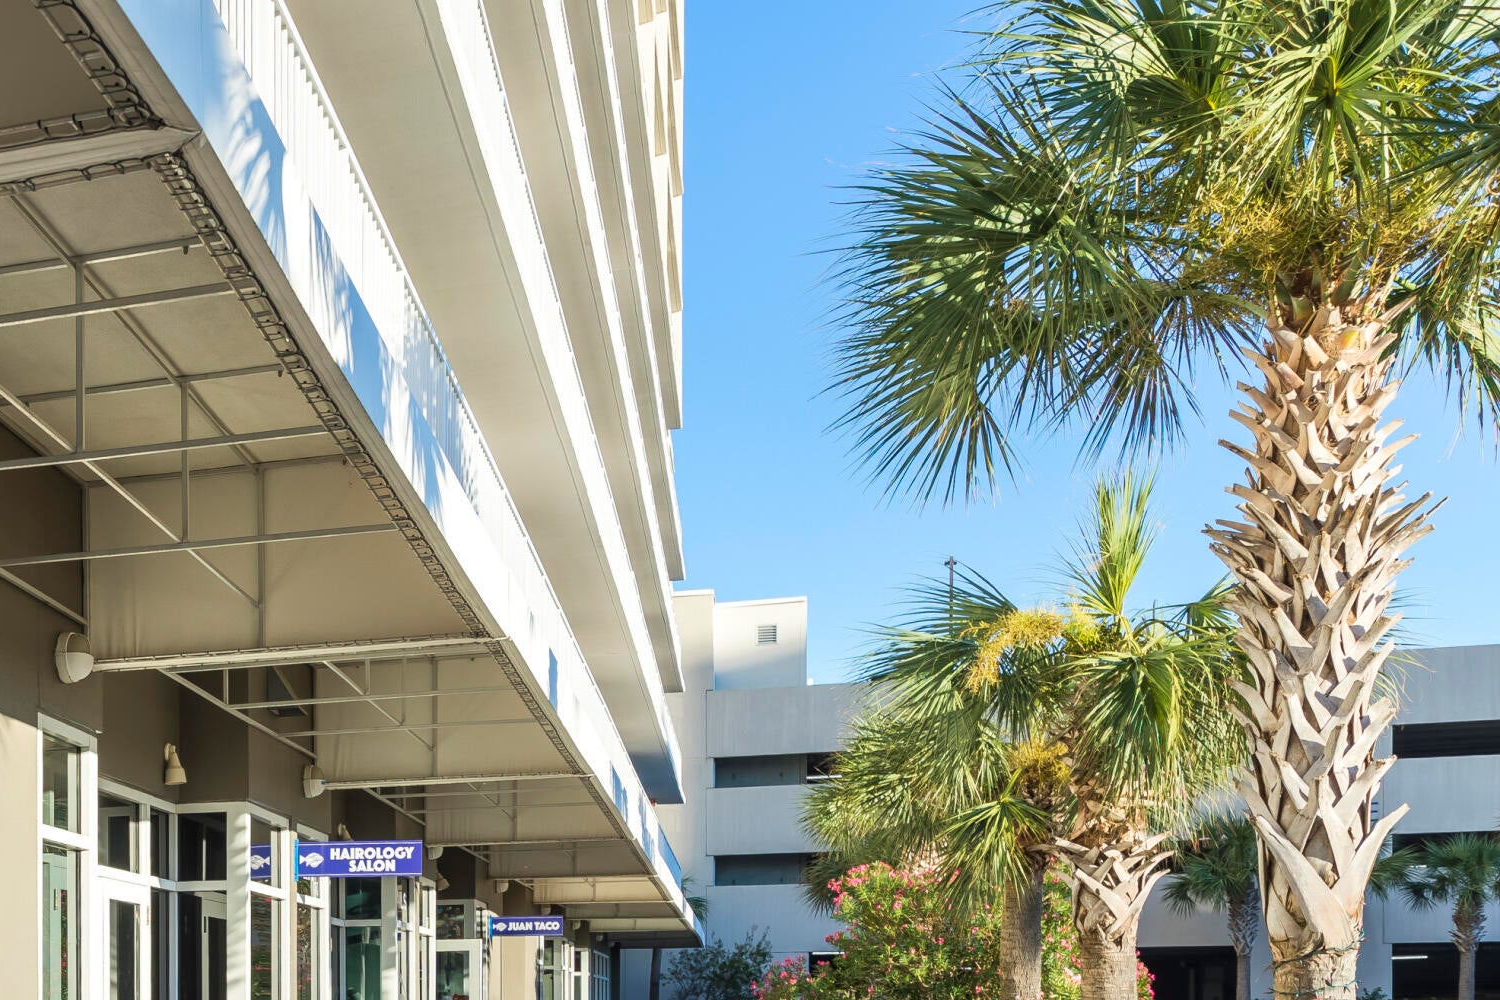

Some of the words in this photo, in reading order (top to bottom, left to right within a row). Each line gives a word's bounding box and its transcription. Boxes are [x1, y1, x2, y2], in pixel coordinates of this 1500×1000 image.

[330, 846, 414, 860] HAIROLOGY
[349, 859, 396, 872] SALON
[507, 921, 533, 931] JUAN
[535, 921, 560, 931] TACO
